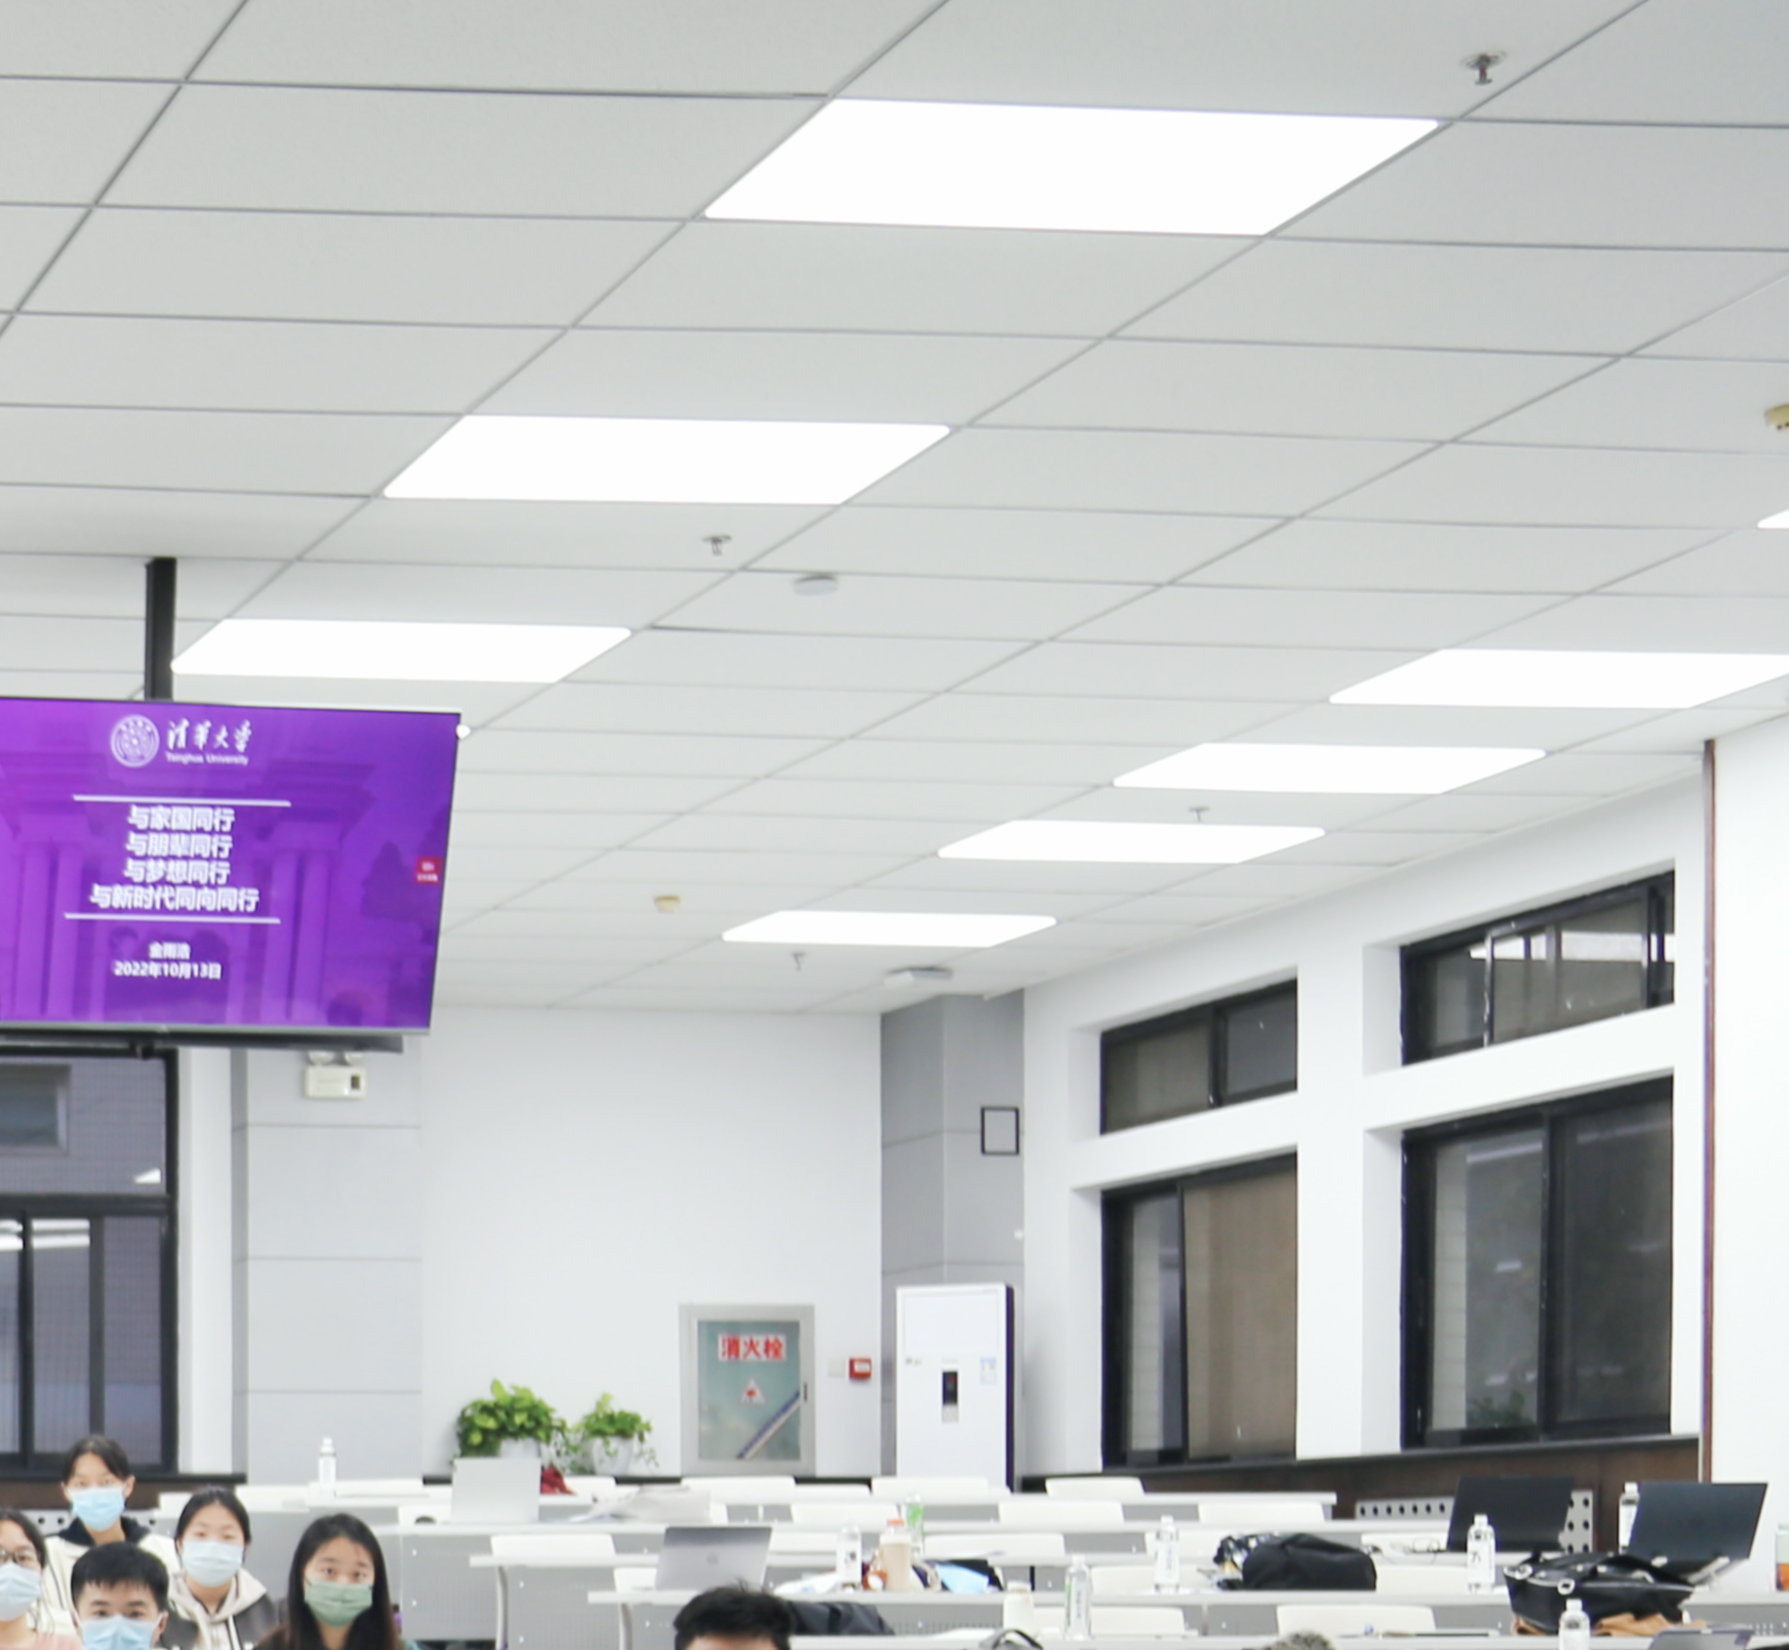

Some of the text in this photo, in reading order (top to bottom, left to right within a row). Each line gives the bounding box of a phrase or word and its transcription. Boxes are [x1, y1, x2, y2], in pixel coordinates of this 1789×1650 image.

[127, 804, 235, 832] 与家国同行
[125, 831, 233, 859] 与朋辈同行
[123, 857, 230, 885] 与梦想同行
[89, 883, 260, 912] 与新时代同向同行
[113, 960, 222, 980] 2022年10月13日
[721, 1334, 784, 1361] 消火栓
